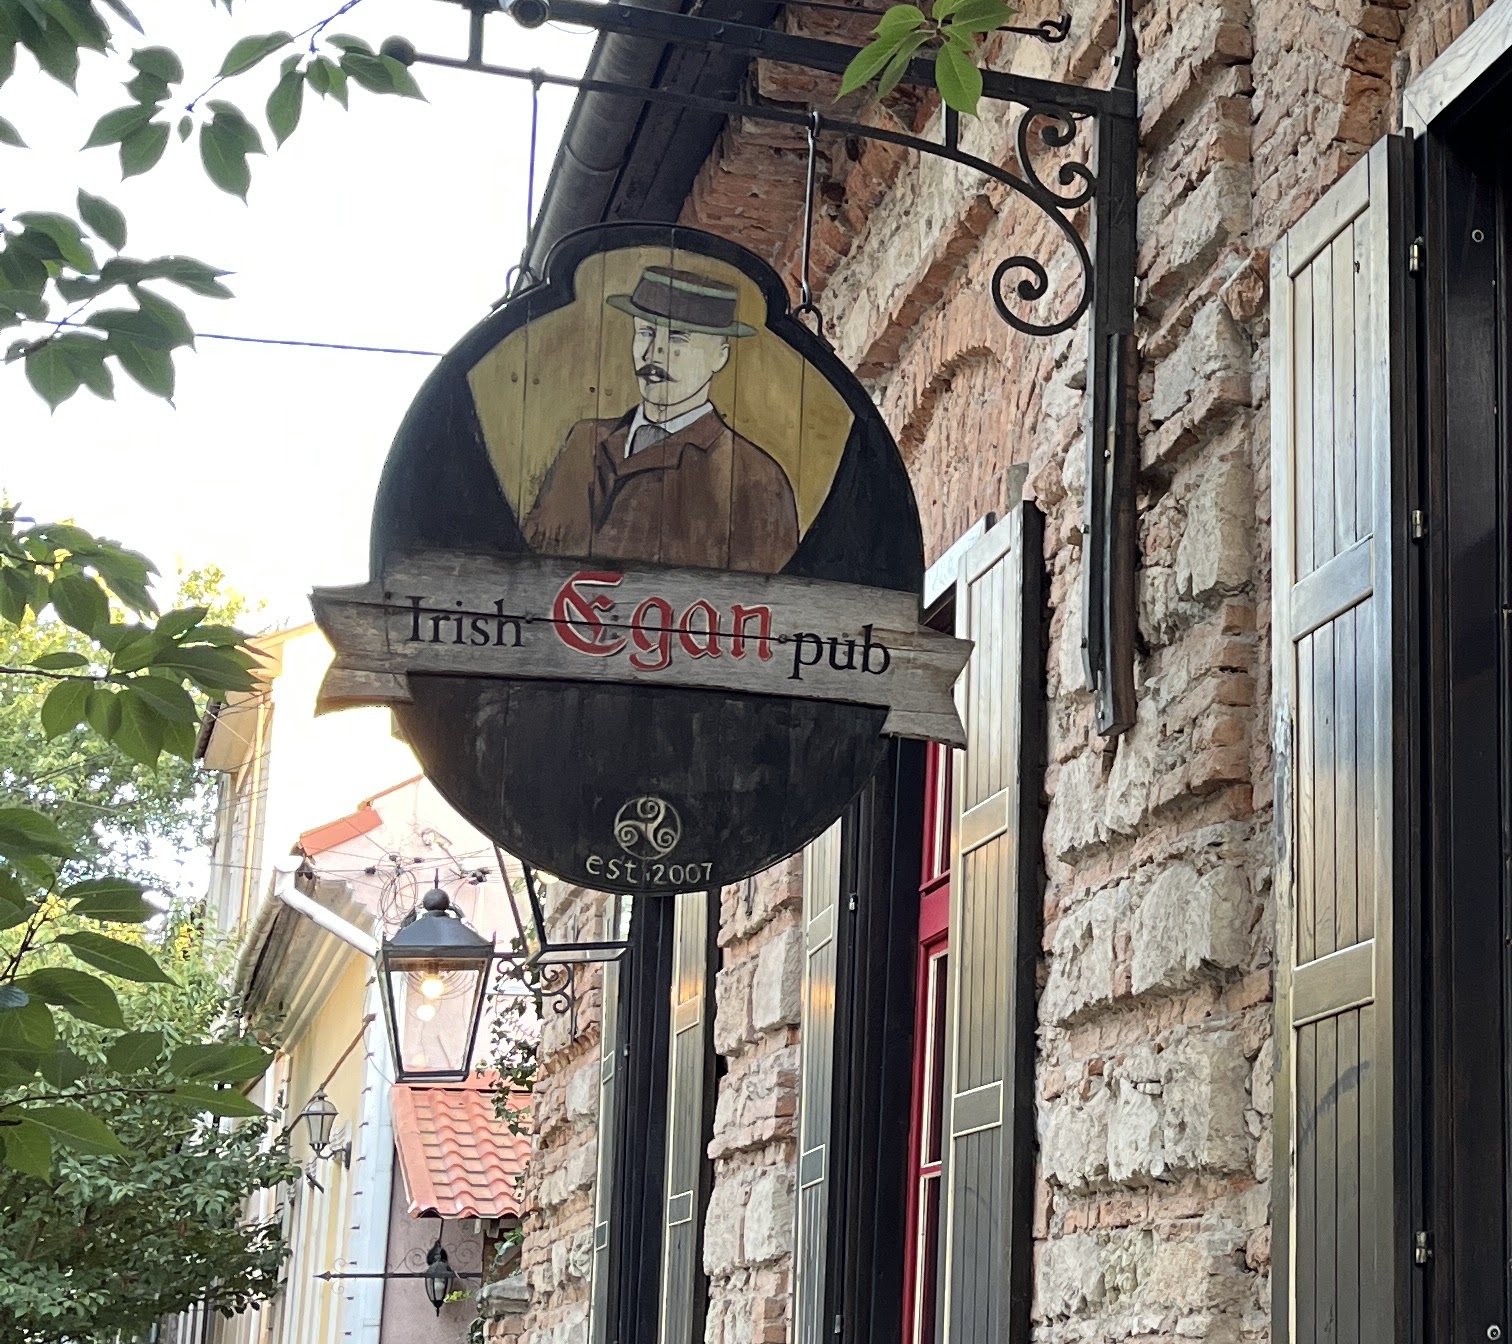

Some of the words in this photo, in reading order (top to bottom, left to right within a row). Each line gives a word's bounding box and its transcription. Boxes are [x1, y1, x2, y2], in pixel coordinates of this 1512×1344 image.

[405, 595, 525, 647] Irish
[552, 570, 773, 671] Egan
[788, 623, 890, 680] pub
[652, 862, 713, 885] 2007
